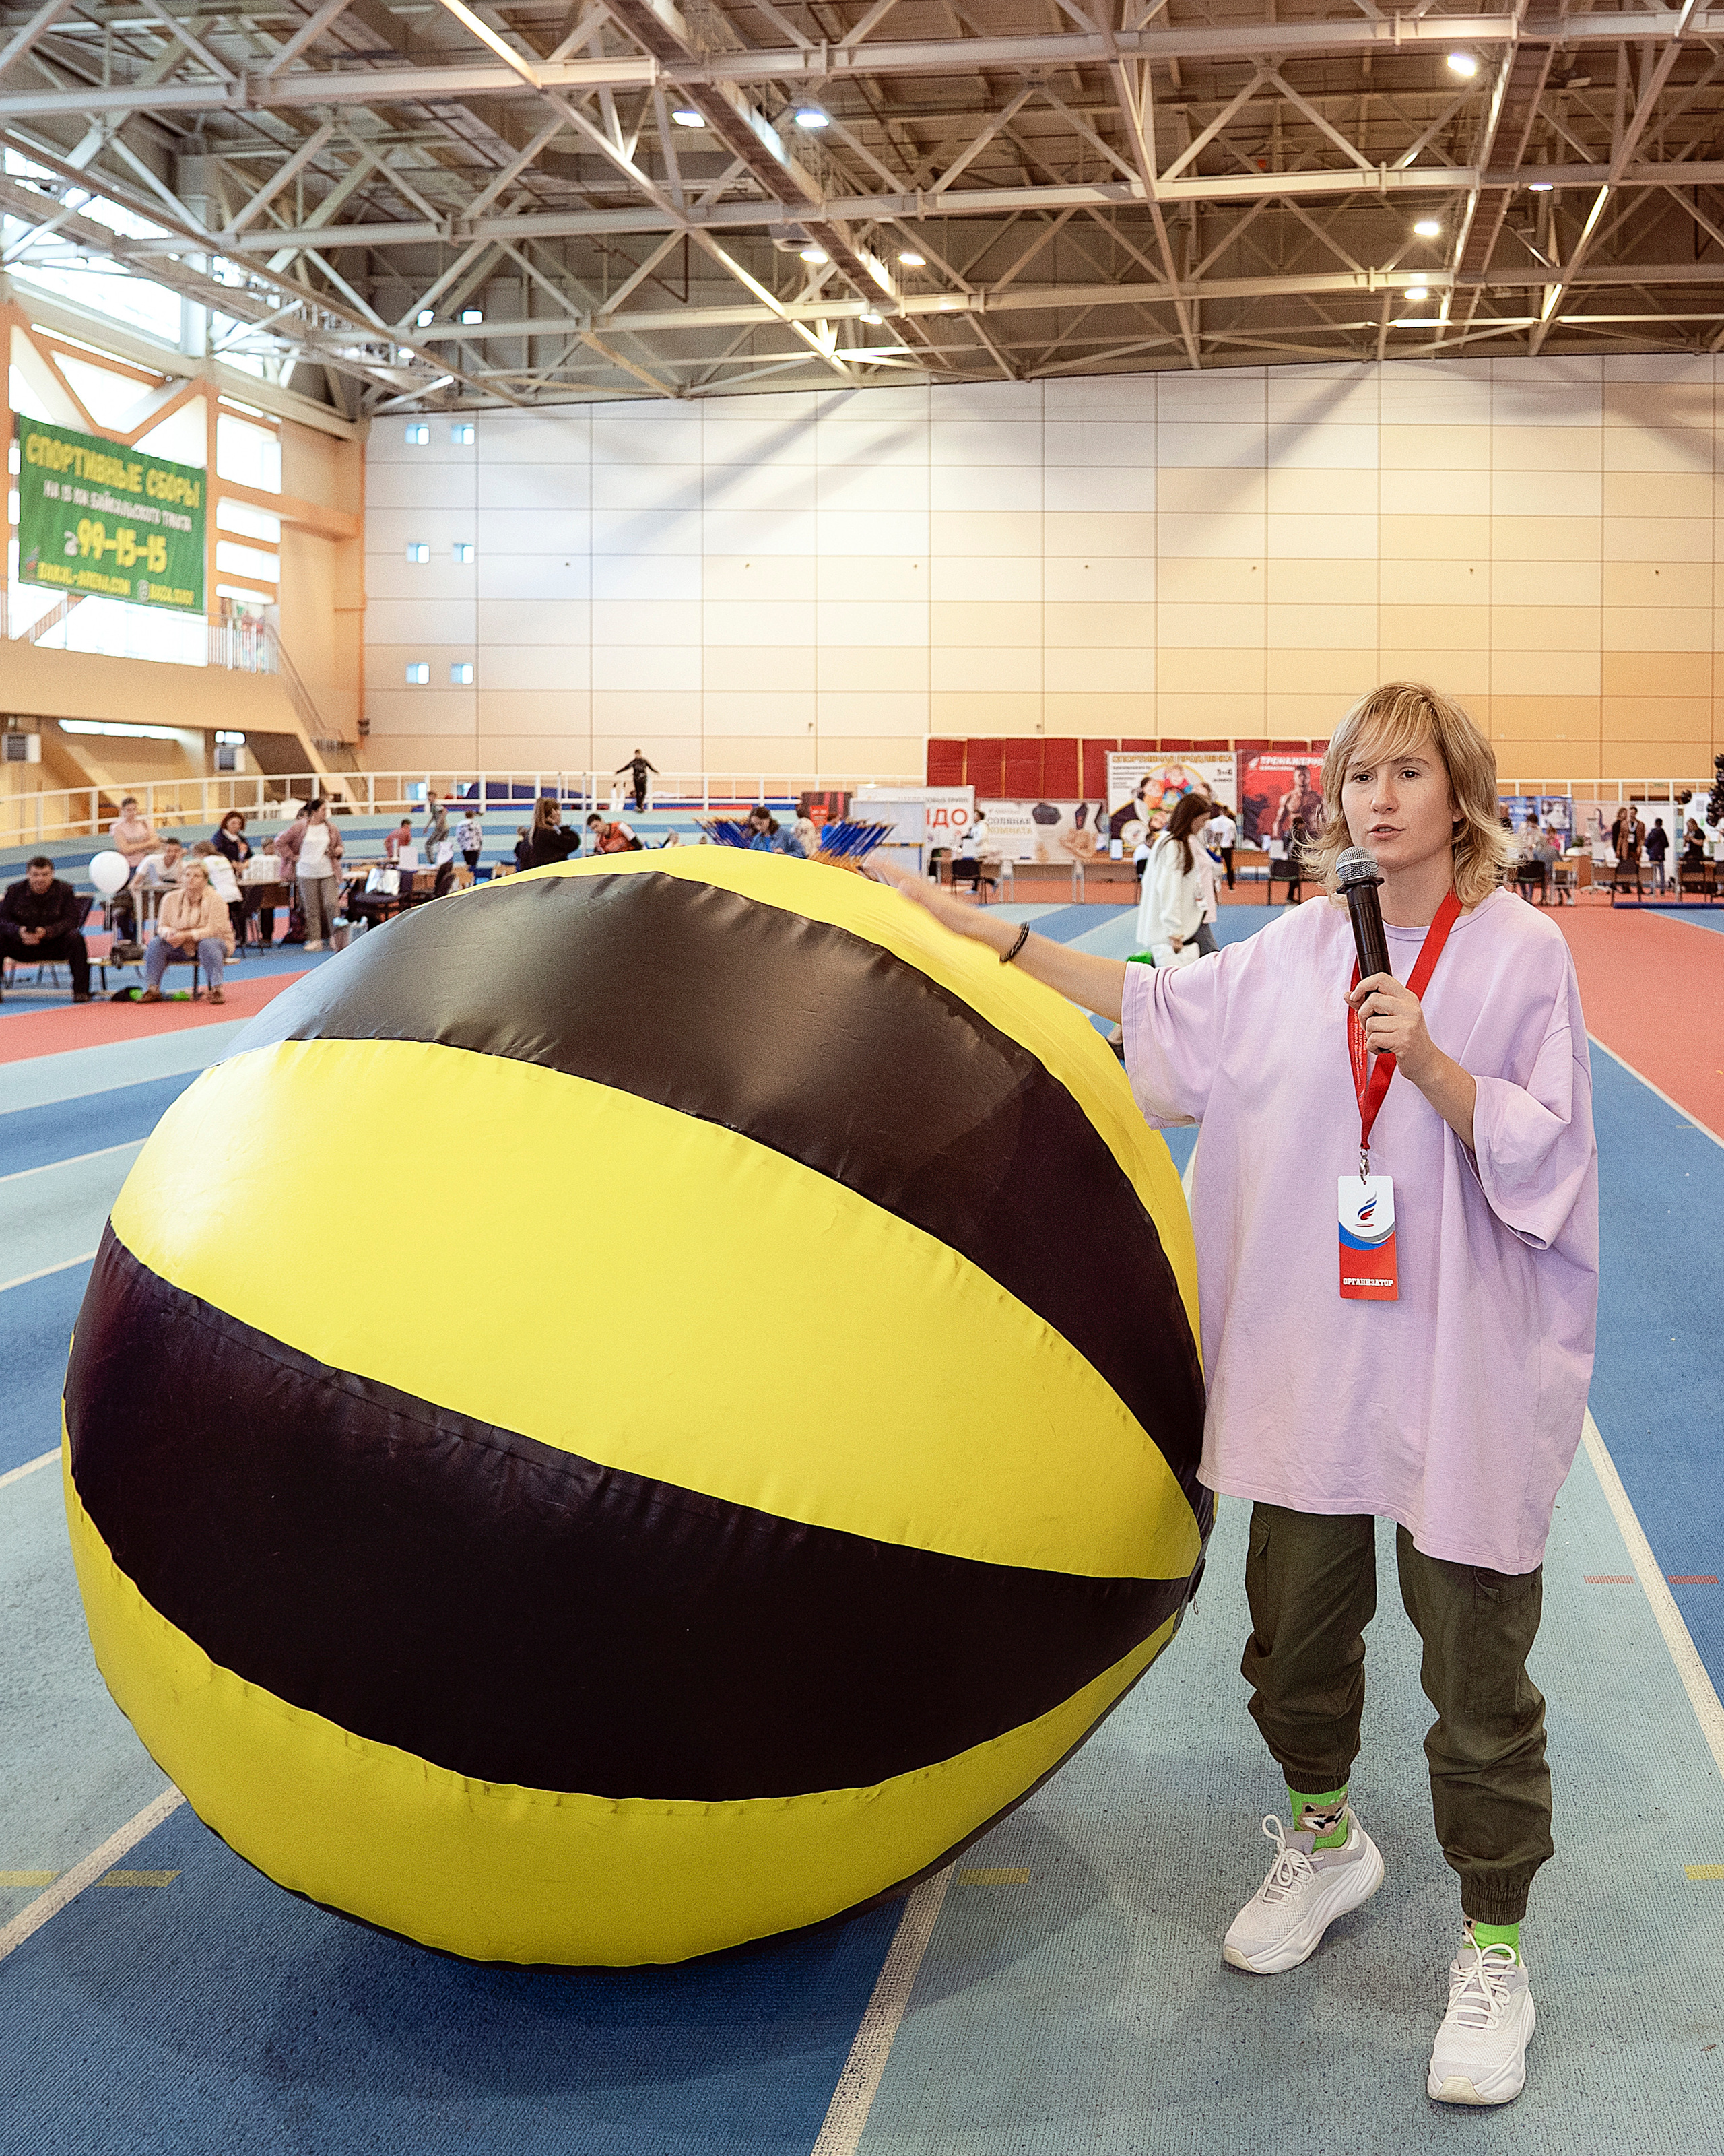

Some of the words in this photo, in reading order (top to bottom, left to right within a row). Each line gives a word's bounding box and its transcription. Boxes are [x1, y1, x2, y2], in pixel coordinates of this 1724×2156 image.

[25, 432, 143, 494] СПОРТИВНЫЕ
[145, 467, 201, 509] СБОРЫ
[76, 517, 168, 574] 99-15-15
[1112, 755, 1174, 764] СПОРТИВНАЯ
[1342, 1277, 1394, 1287] ОРГАНИЗАТОР
